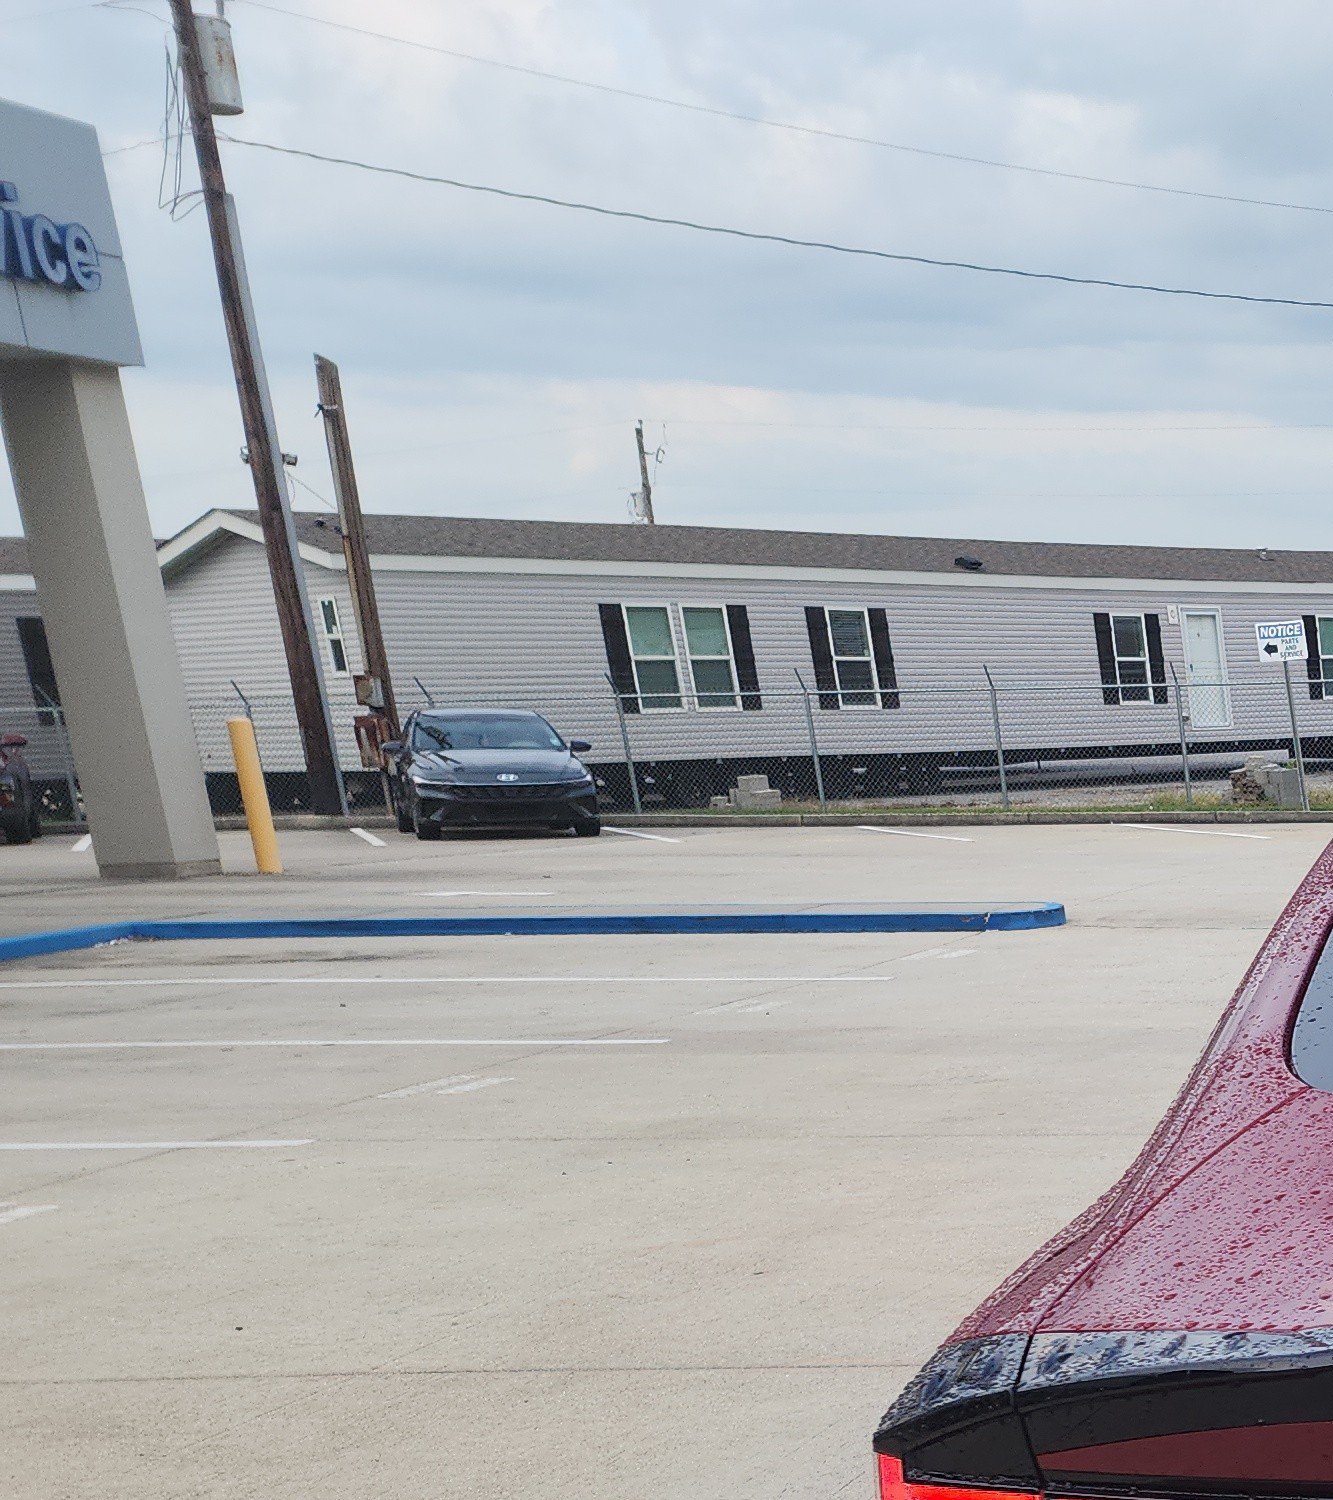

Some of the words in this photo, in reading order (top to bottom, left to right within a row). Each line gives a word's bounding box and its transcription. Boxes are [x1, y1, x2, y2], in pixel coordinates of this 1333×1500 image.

[0, 180, 101, 292] ice
[1260, 624, 1301, 638] NOTICE
[1281, 637, 1299, 645] PARTS
